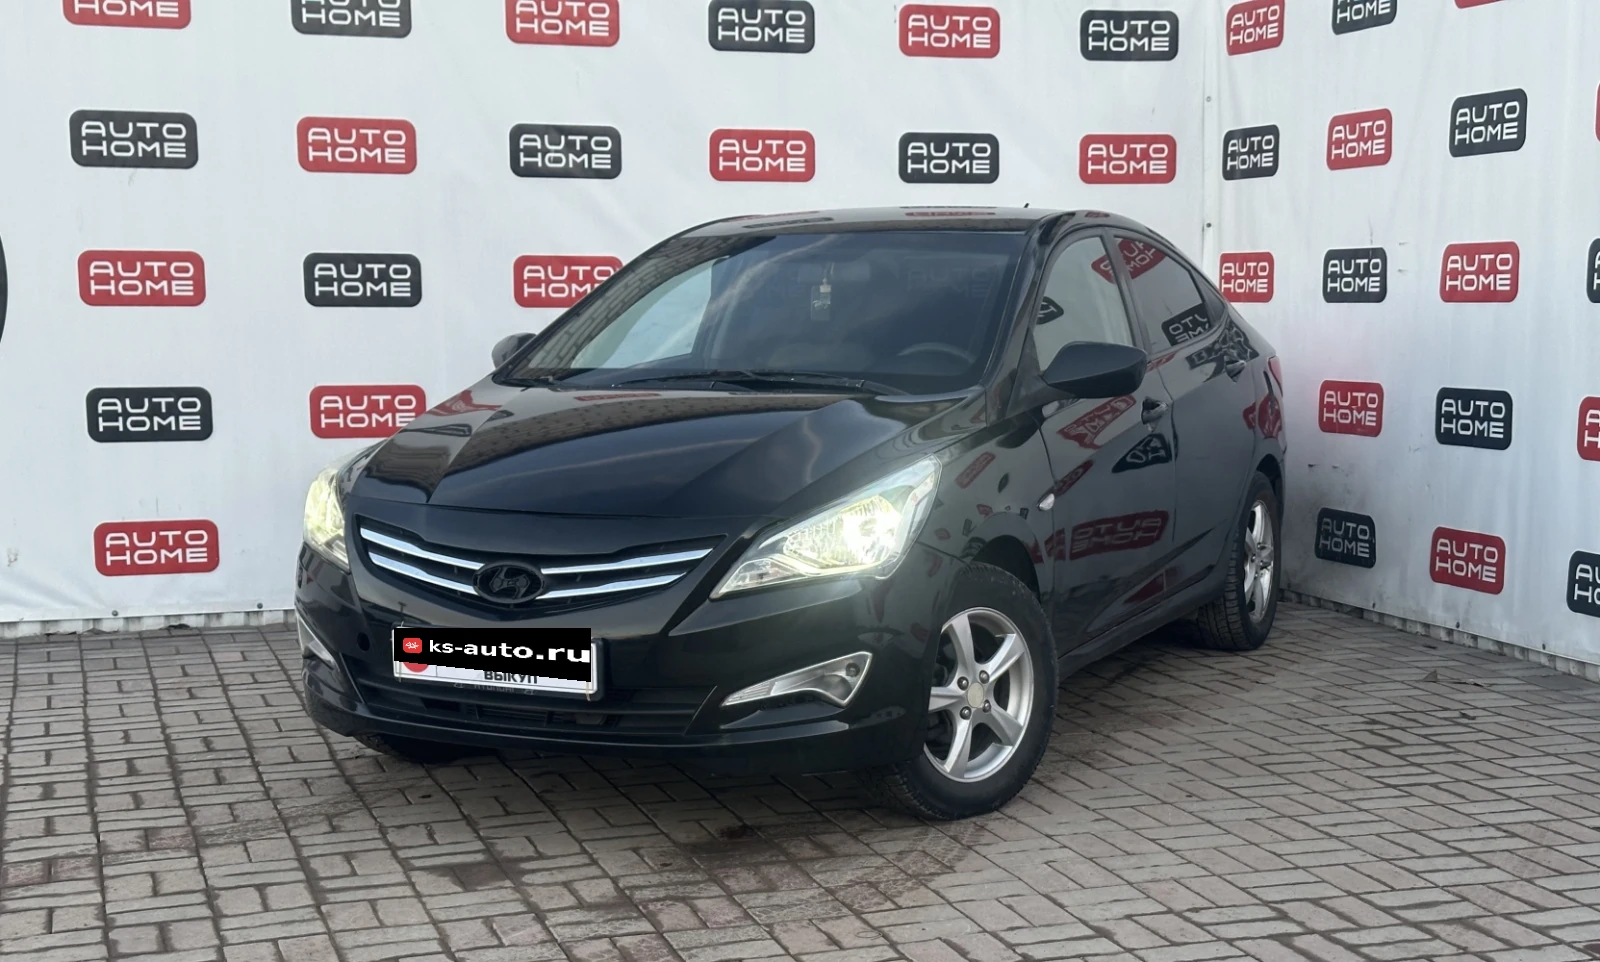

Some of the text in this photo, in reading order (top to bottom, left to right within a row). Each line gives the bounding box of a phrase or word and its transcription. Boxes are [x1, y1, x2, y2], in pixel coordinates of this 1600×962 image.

[74, 0, 179, 18] HOME
[302, 8, 400, 27] HOME
[516, 0, 610, 18] AUTO
[718, 8, 806, 25] AUTO
[1231, 5, 1280, 28] AUTO
[1337, 0, 1390, 23] HOME
[516, 18, 609, 36] HOME
[908, 15, 992, 31] AUTO
[1089, 20, 1170, 34] AUTO
[718, 26, 804, 43] HOME
[908, 32, 990, 48] HOME
[1230, 23, 1278, 45] HOME
[1089, 37, 1169, 51] HOME
[1456, 101, 1519, 125] AUTO
[82, 121, 186, 139] AUTO
[308, 128, 406, 145] AUTO
[1333, 120, 1386, 141] AUTO
[1455, 122, 1518, 145] HOME
[82, 140, 186, 158] HOME
[520, 134, 612, 151] AUTO
[719, 139, 806, 154] AUTO
[908, 142, 991, 157] AUTO
[1088, 144, 1168, 157] AUTO
[1228, 135, 1274, 153] AUTO
[1332, 139, 1385, 159] HOME
[309, 146, 405, 163] HOME
[520, 152, 611, 168] HOME
[1227, 152, 1273, 170] HOME
[719, 157, 805, 172] HOME
[908, 159, 990, 173] HOME
[1088, 160, 1167, 174] HOME
[90, 261, 194, 277] AUTO
[1221, 262, 1269, 276] AUTO
[1328, 259, 1381, 274] AUTO
[1447, 254, 1512, 271] AUTO
[314, 264, 411, 279] AUTO
[524, 265, 615, 281] AUTO
[90, 280, 193, 295] HOME
[315, 281, 411, 296] HOME
[524, 283, 601, 298] HOM
[1221, 279, 1268, 293] HOME
[1328, 277, 1380, 292] HOME
[1446, 274, 1511, 290] HOME
[98, 398, 201, 413] AUTO
[320, 395, 416, 410] AUTO
[1324, 391, 1378, 408] AUTO
[1324, 408, 1376, 426] HOME
[1442, 399, 1505, 418] AUTO
[99, 416, 201, 431] HOME
[321, 412, 416, 428] HOME
[1441, 418, 1504, 438] HOME
[1321, 518, 1369, 540] AUTO
[106, 530, 208, 547] AUTO
[1319, 536, 1369, 557] HOME
[106, 548, 207, 565] HOME
[1437, 539, 1498, 563] AUTO
[1436, 557, 1496, 582] HOME
